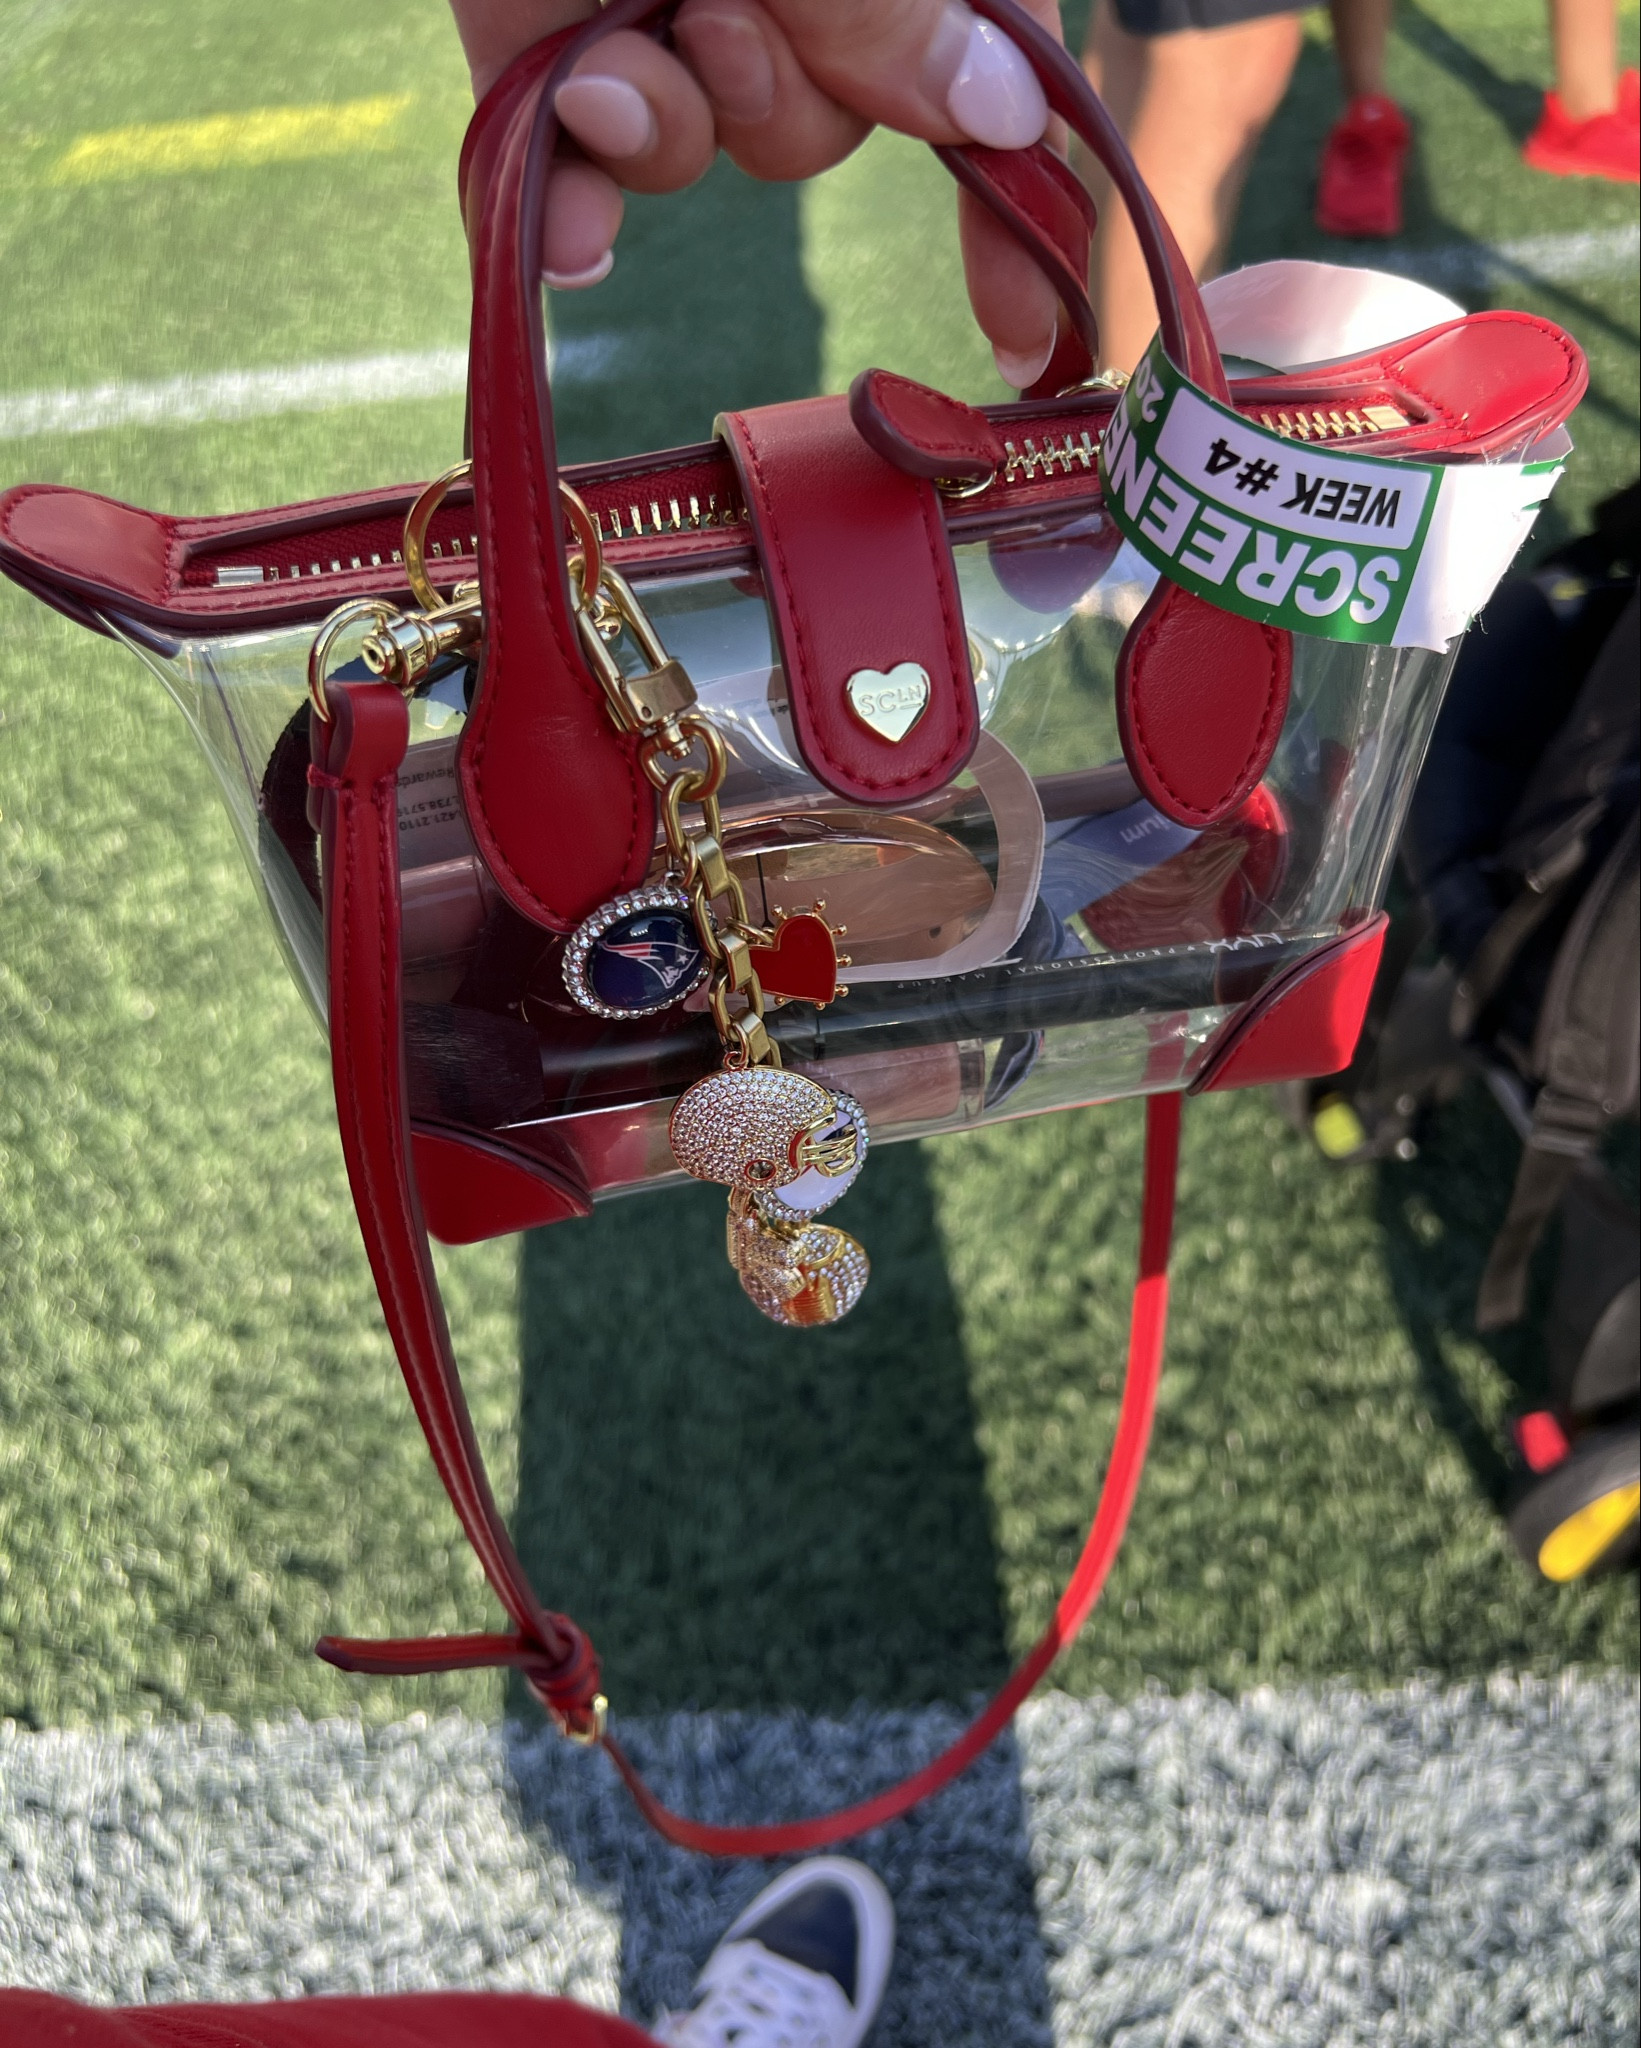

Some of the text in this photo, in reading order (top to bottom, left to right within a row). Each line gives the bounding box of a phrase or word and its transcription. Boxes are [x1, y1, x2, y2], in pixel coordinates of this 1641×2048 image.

[1135, 357, 1165, 423] 20
[1103, 396, 1399, 625] SCREENE
[1203, 438, 1400, 529] WEEK #4
